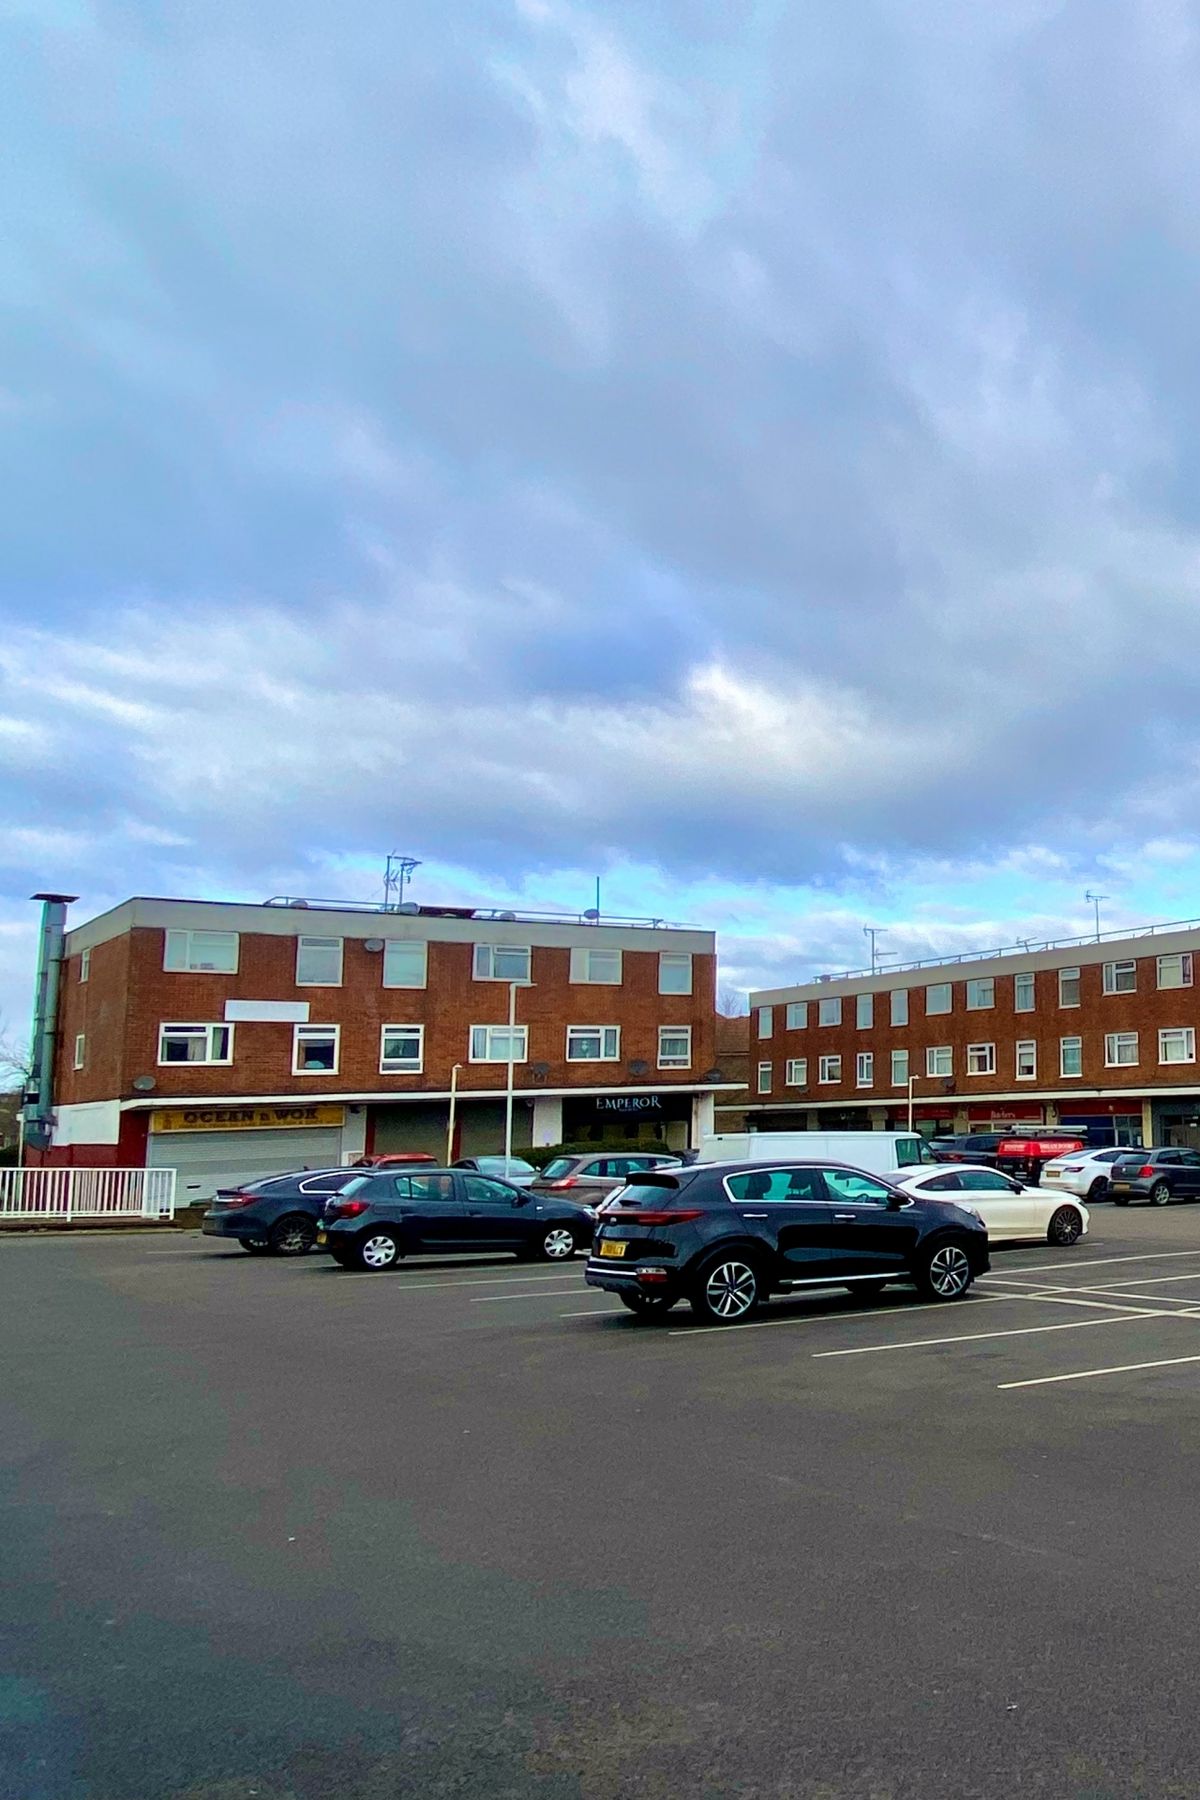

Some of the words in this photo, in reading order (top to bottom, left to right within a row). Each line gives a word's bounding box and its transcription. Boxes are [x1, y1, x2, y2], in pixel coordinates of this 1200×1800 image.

[596, 1095, 662, 1110] EMPEROR
[183, 1109, 255, 1123] OCEAN
[273, 1108, 318, 1121] WOK
